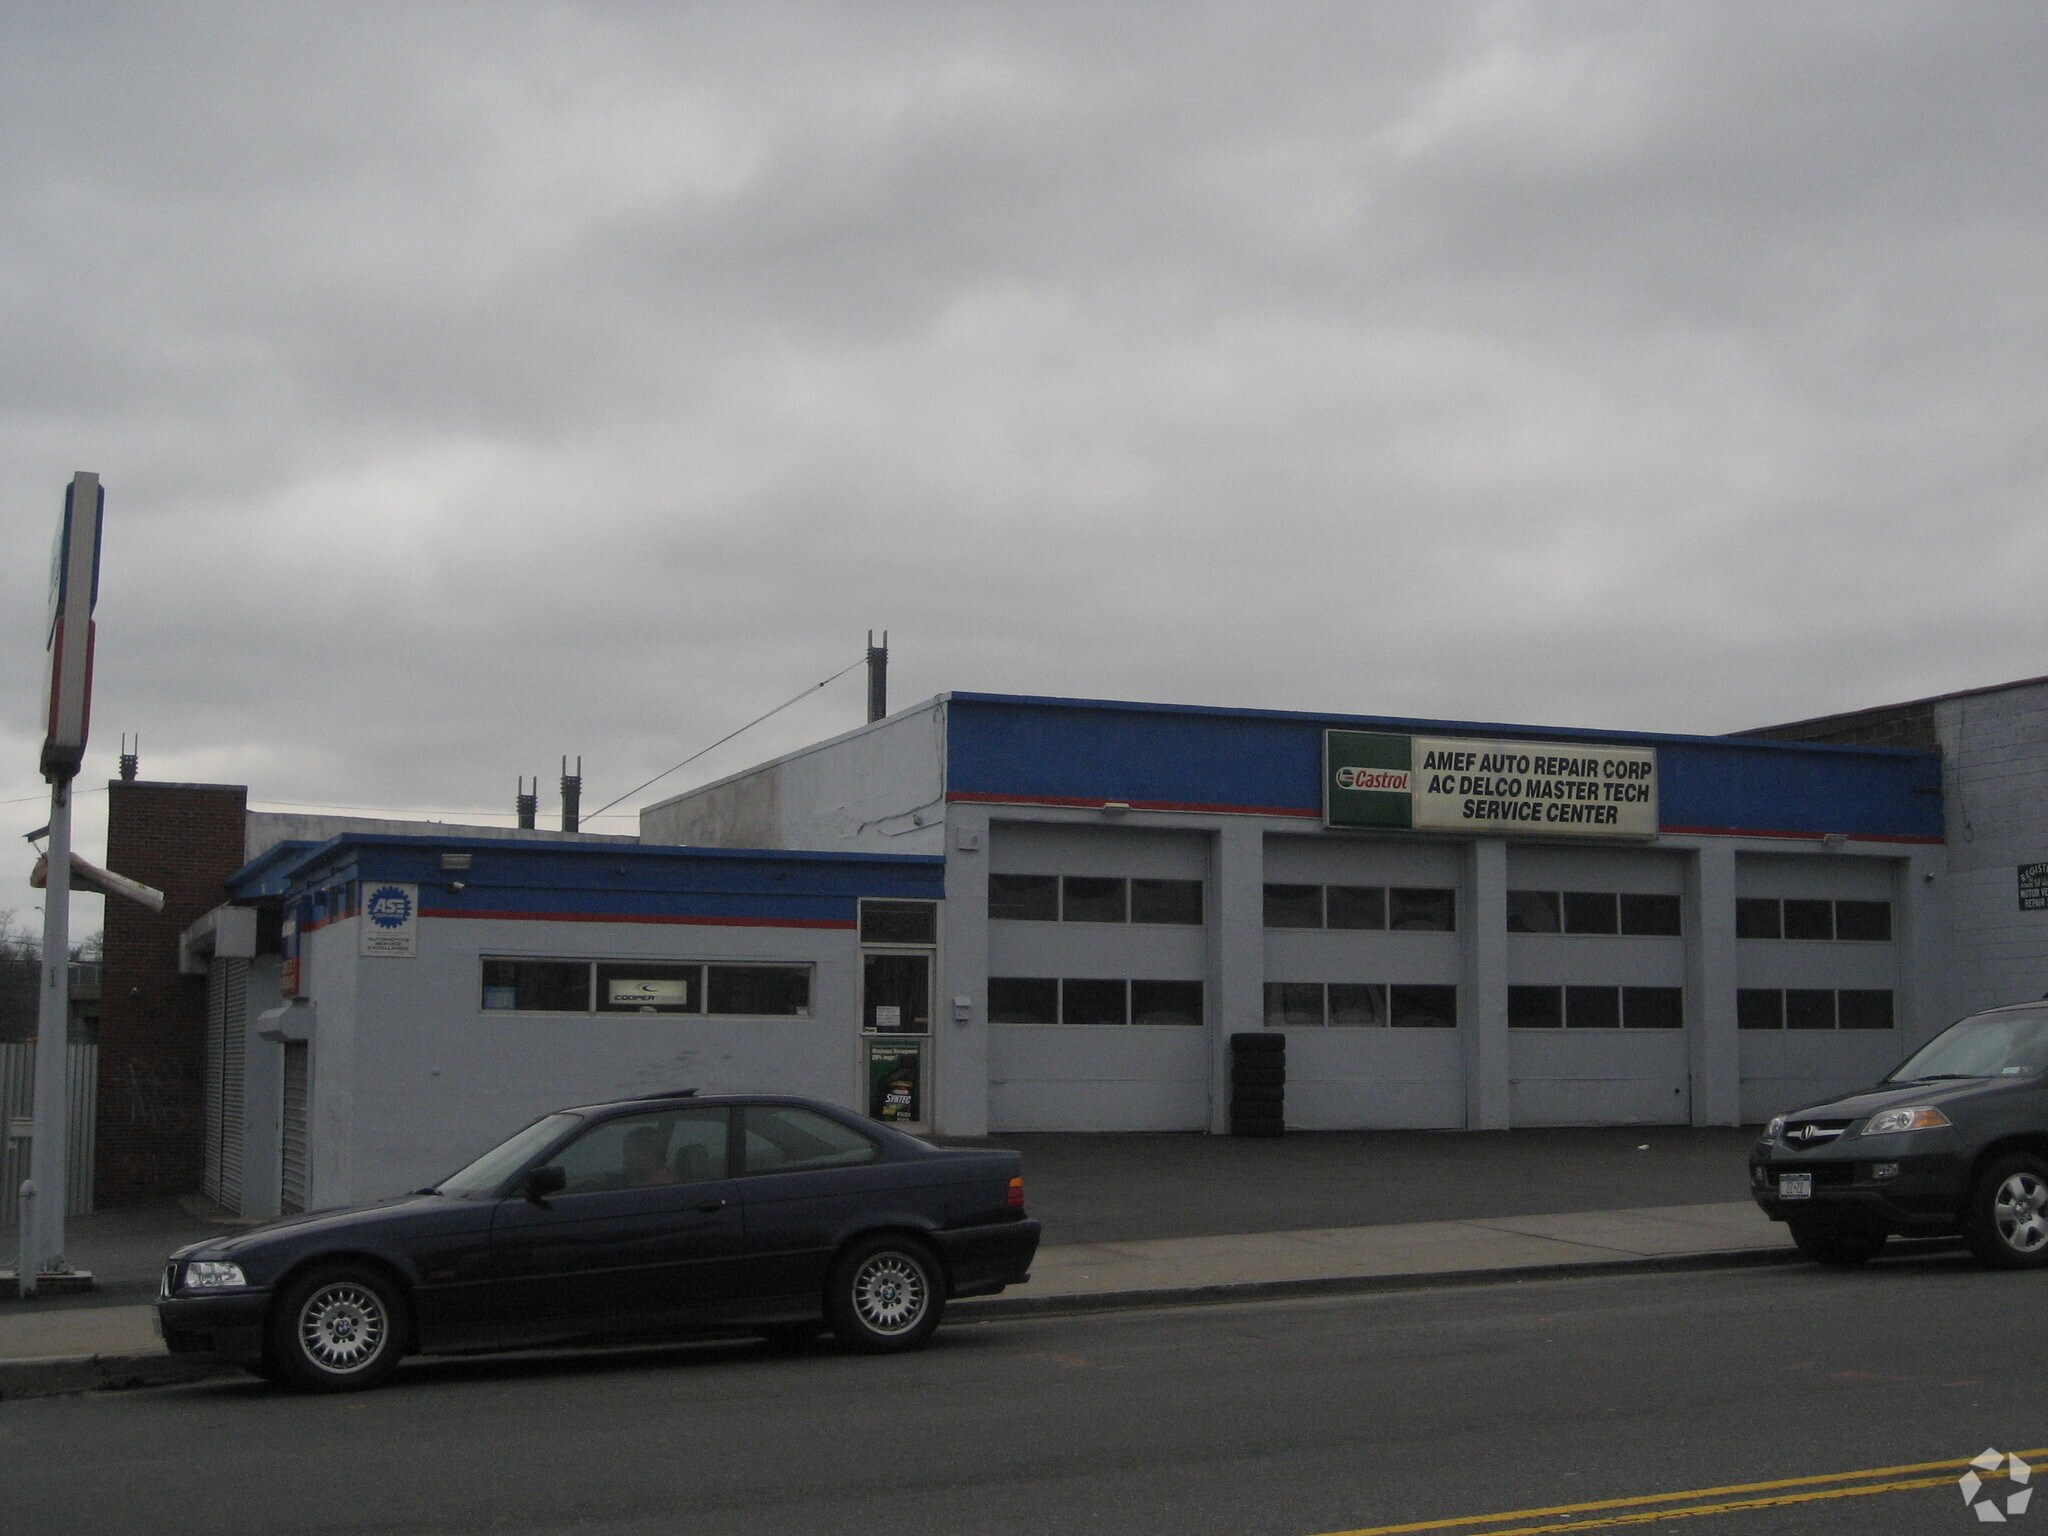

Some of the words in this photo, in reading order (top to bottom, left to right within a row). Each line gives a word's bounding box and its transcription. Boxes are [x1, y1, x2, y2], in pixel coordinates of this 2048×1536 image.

[1423, 751, 1476, 771] AMEF
[1480, 753, 1530, 774] AUTO
[1534, 756, 1598, 777] REPAIR
[1603, 760, 1652, 780] CORP
[1355, 770, 1408, 790] Castrol
[1427, 774, 1455, 795] AC
[1459, 776, 1521, 797] DELCO
[1526, 779, 1599, 801] MASTER
[1603, 782, 1650, 803] TECH
[1462, 799, 1542, 821] SERVICE
[1546, 802, 1618, 824] CENTER
[373, 898, 405, 914] ASE
